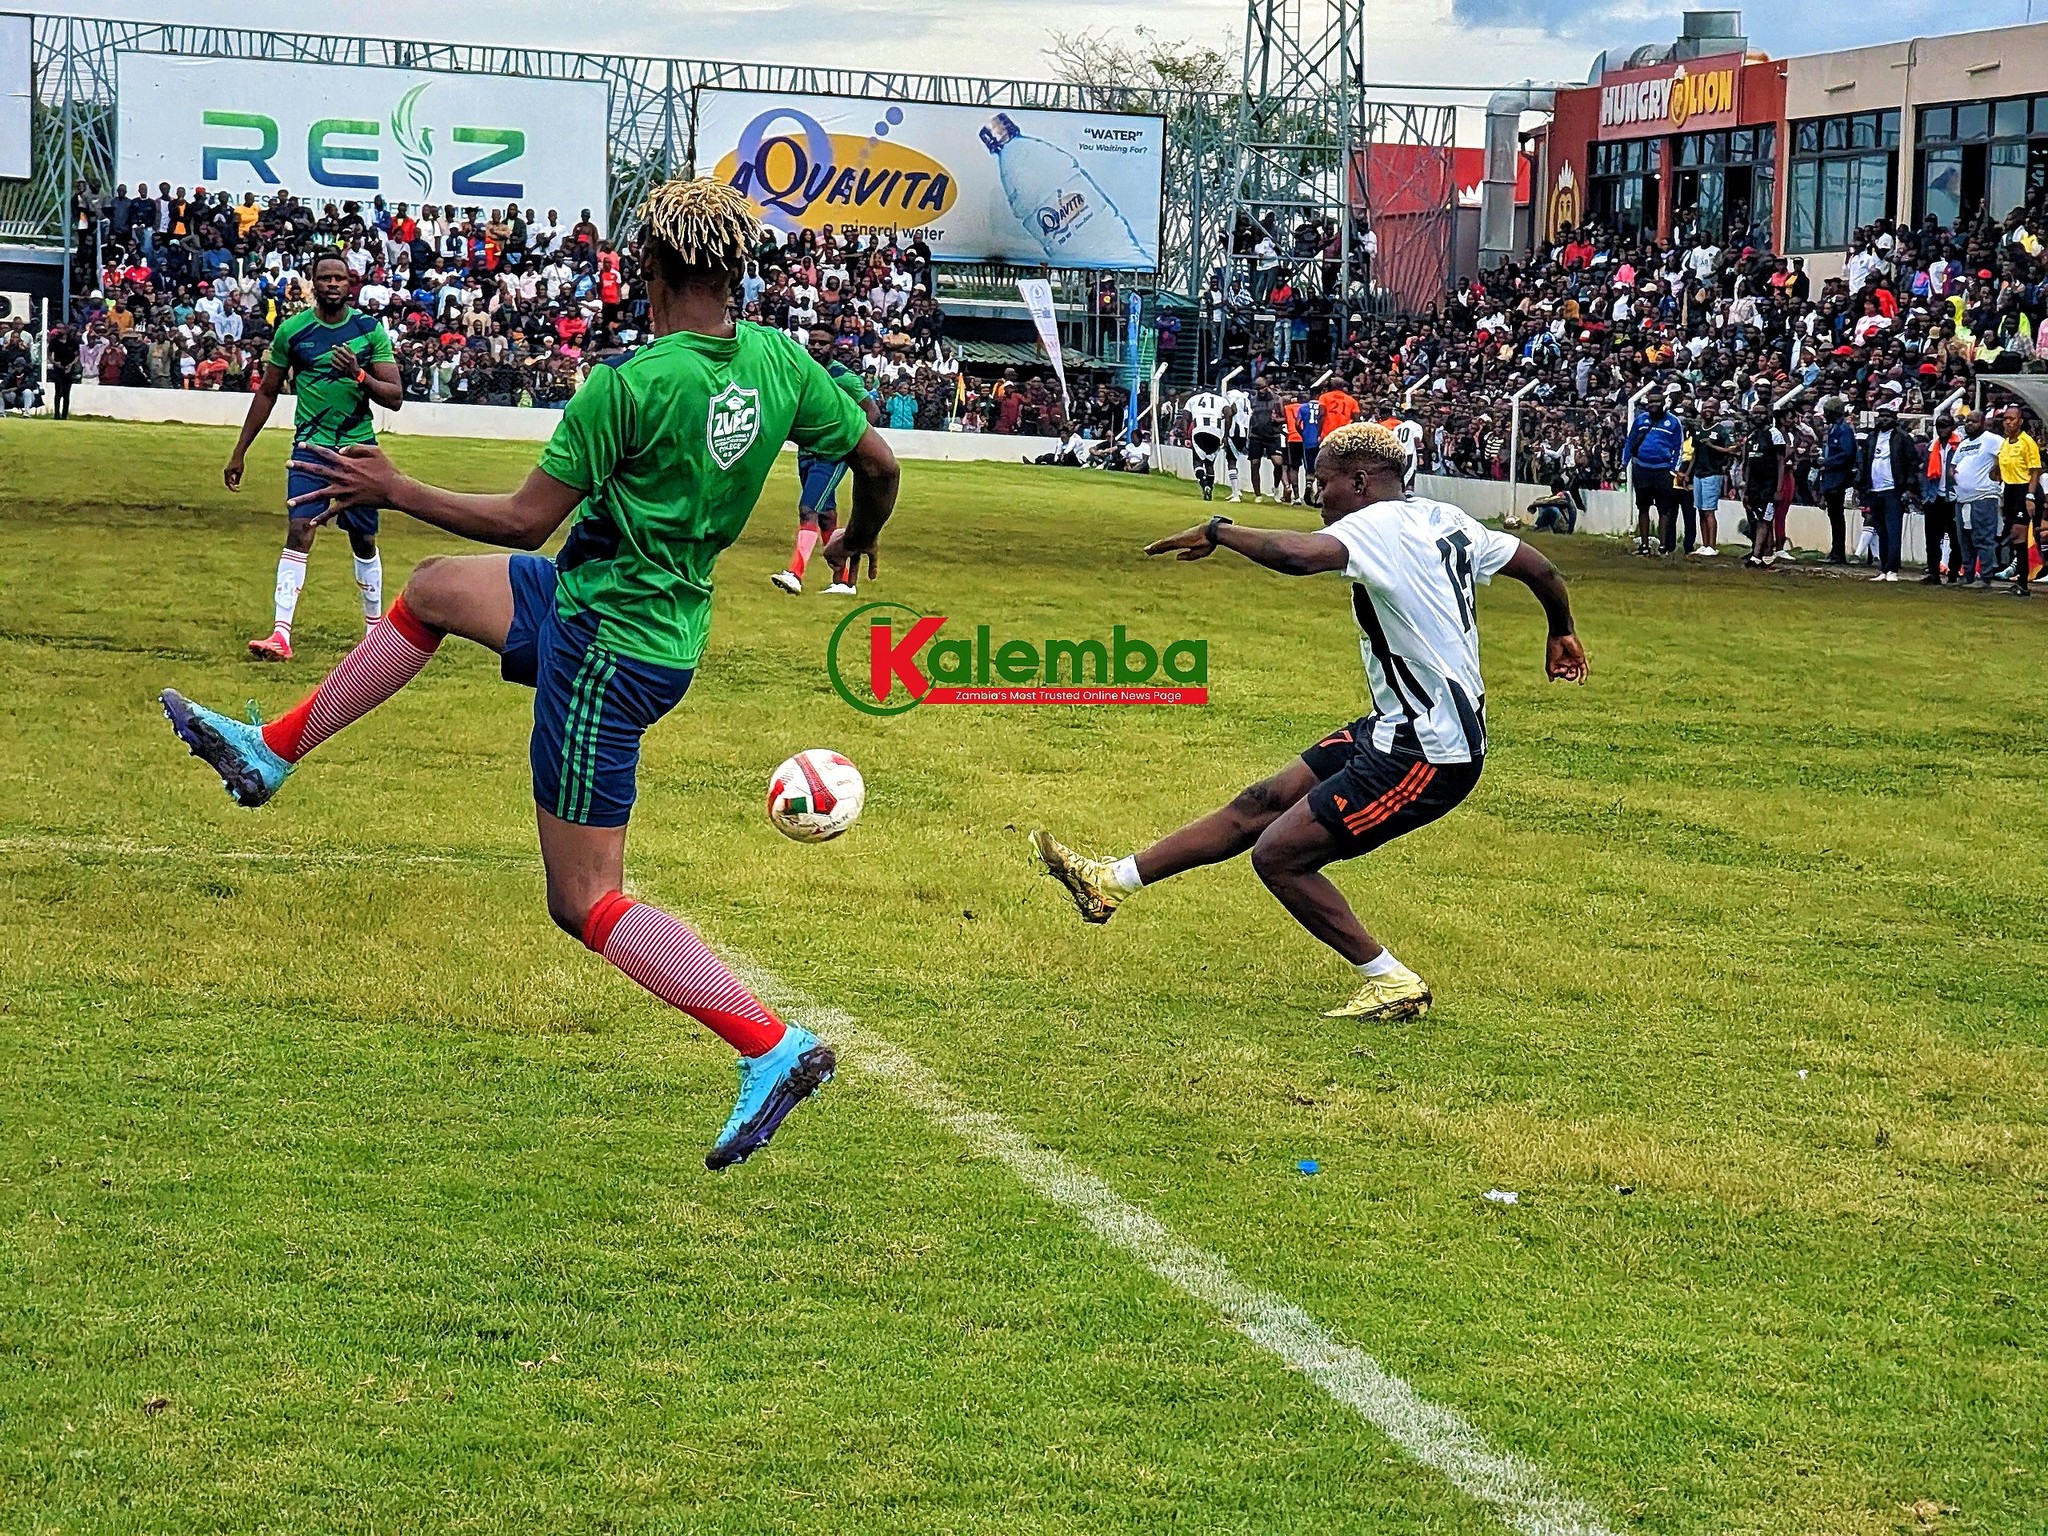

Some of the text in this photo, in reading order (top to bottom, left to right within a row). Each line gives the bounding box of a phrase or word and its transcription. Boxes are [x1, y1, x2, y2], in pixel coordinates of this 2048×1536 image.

[1602, 70, 1733, 126] HUNGRY LION
[1079, 143, 1148, 154] You Waiting For?
[1198, 396, 1214, 408] 41
[1329, 400, 1346, 415] 21
[1398, 427, 1410, 443] 10
